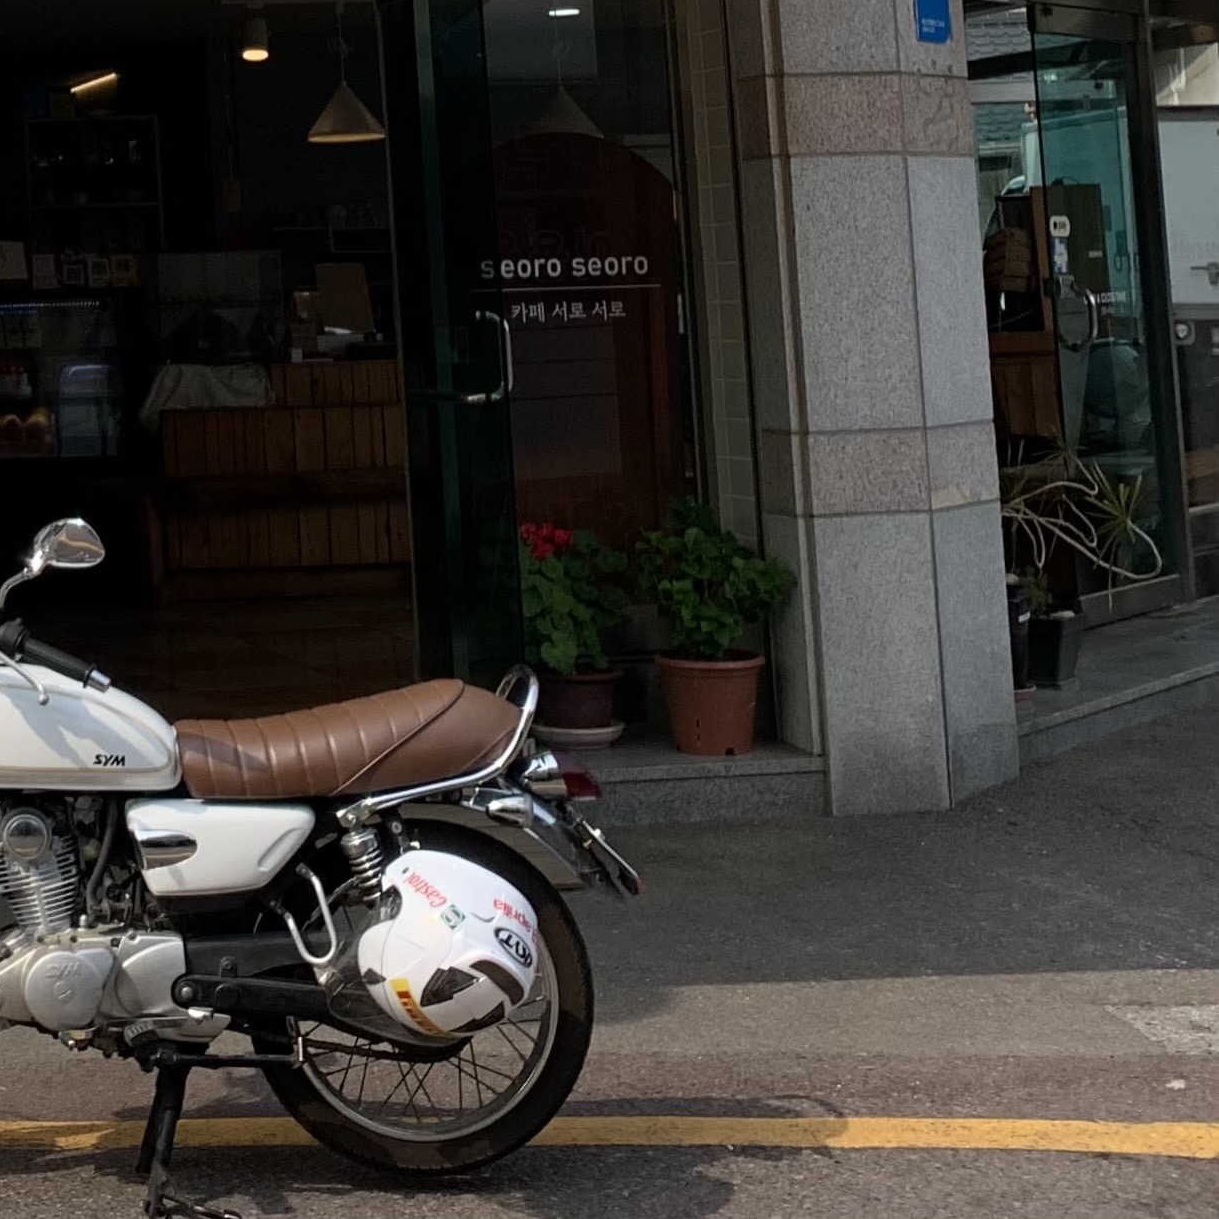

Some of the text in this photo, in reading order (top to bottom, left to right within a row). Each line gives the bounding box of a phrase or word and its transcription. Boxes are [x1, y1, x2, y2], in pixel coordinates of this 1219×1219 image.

[480, 256, 648, 279] seoro seoro
[511, 300, 626, 323] 카페 서로 서로
[93, 753, 125, 767] SYM
[403, 871, 448, 908] Castrol
[493, 898, 532, 932] aprilia
